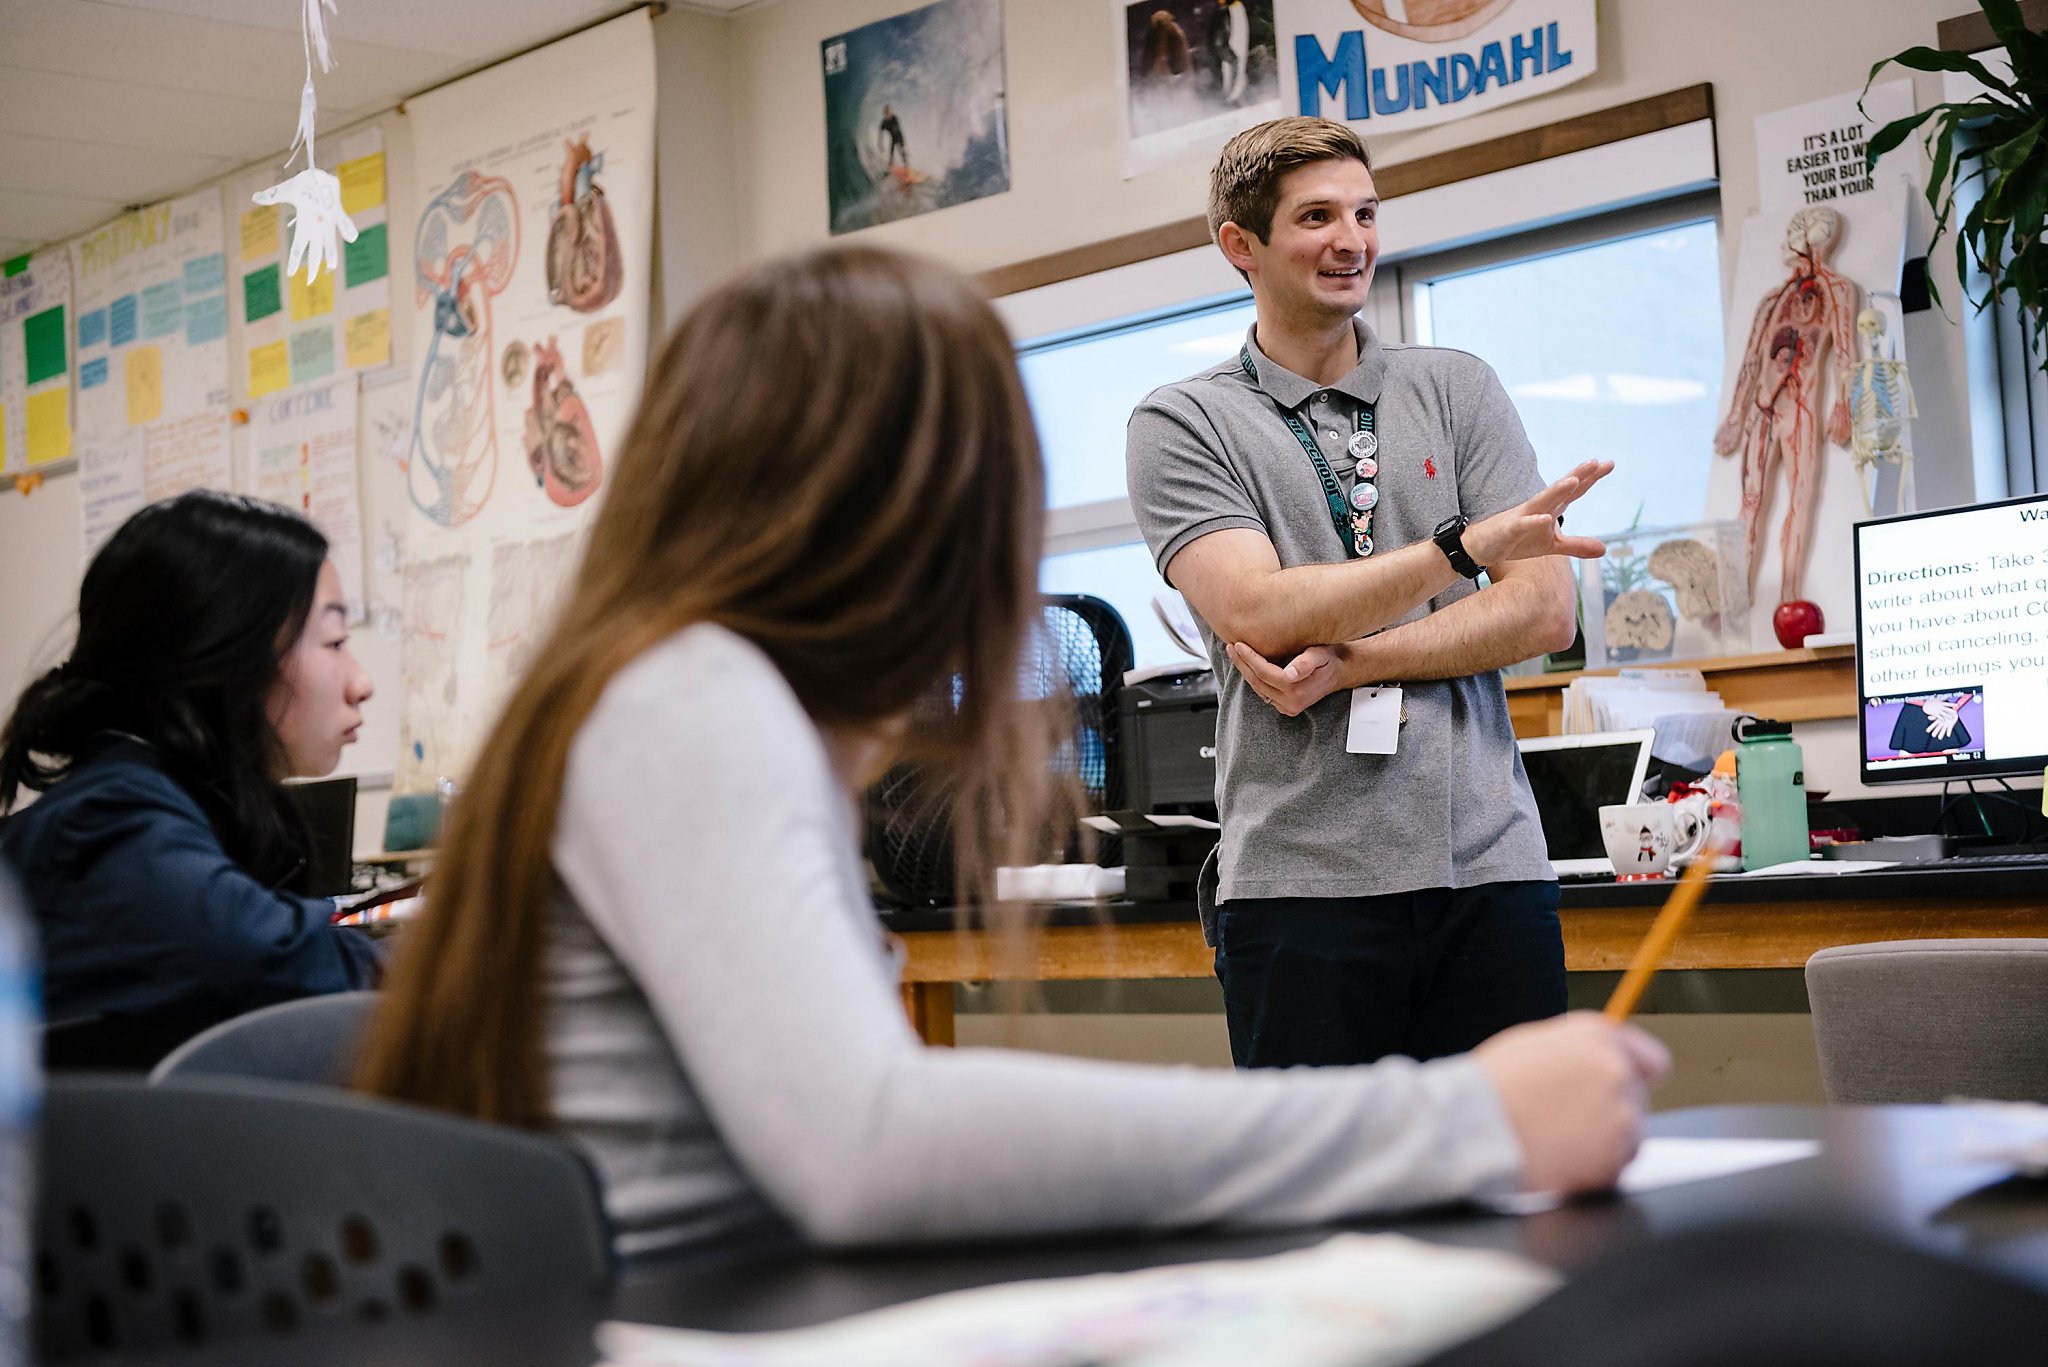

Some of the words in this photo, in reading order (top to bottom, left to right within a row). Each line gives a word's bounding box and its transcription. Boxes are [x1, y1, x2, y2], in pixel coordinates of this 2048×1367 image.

[1294, 21, 1572, 121] MUNDAHL
[1803, 133, 1827, 151] IT'S
[1830, 131, 1839, 147] A
[1840, 124, 1864, 142] LOT
[1787, 150, 1831, 173] EASIER
[1834, 147, 1849, 162] TO
[1852, 142, 1864, 158] W
[1803, 168, 1836, 187] YOUR
[1840, 161, 1866, 179] BUT
[1804, 185, 1837, 204] THAN
[1840, 178, 1874, 196] YOUR
[1360, 412, 1373, 431] HIG
[2020, 508, 2048, 522] Wa
[1868, 562, 1979, 585] Directions:
[1987, 553, 2034, 570] Take
[1867, 594, 1912, 610] write
[1919, 585, 1974, 604] about
[1980, 578, 2028, 596] what
[1868, 621, 1902, 639] you
[1909, 614, 1956, 630] have
[1963, 605, 2019, 624] about
[1869, 639, 1931, 659] school
[1938, 630, 2039, 651] canceling,
[1870, 668, 1919, 684] other
[1926, 660, 2002, 678] feelings
[2009, 655, 2045, 673] you
